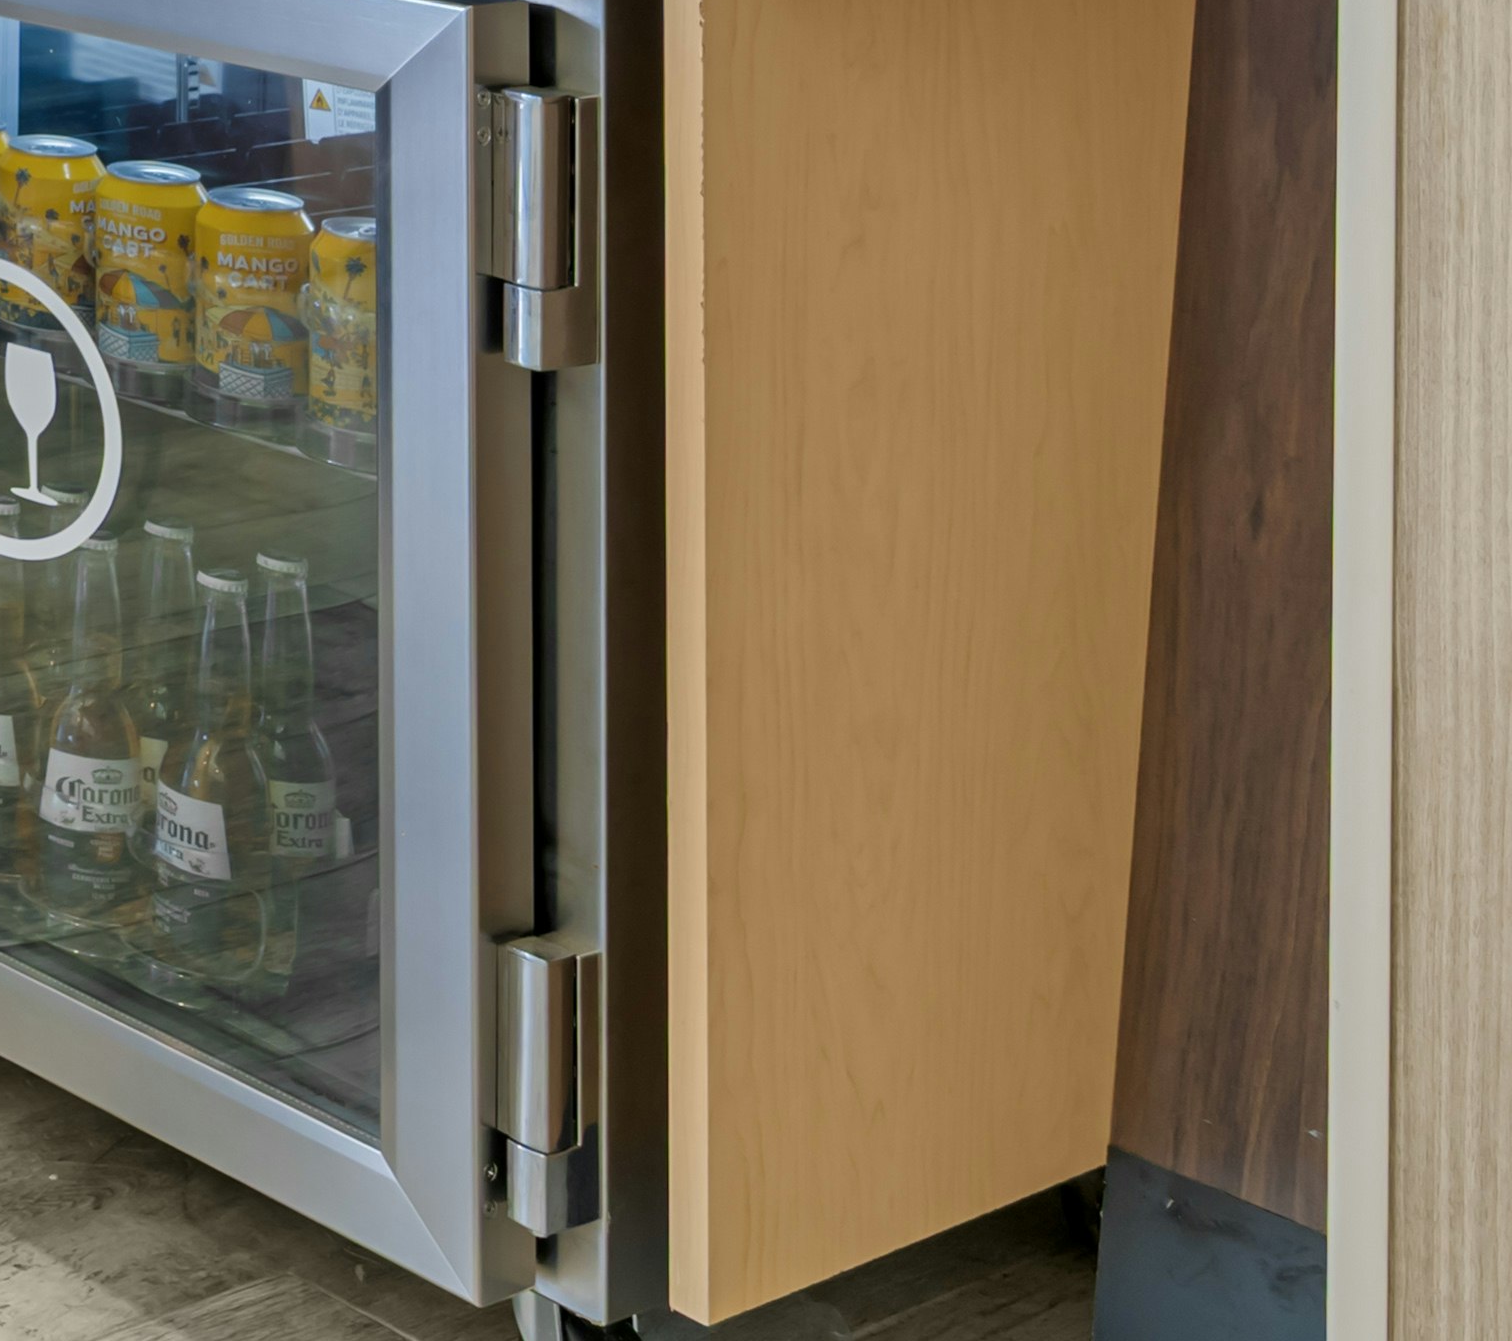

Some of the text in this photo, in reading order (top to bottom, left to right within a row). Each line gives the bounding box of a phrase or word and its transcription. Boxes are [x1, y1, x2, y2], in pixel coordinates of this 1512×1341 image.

[97, 217, 166, 242] MANGO
[219, 234, 264, 247] GOLDEN
[217, 252, 298, 273] MANGO
[227, 271, 288, 289] CART
